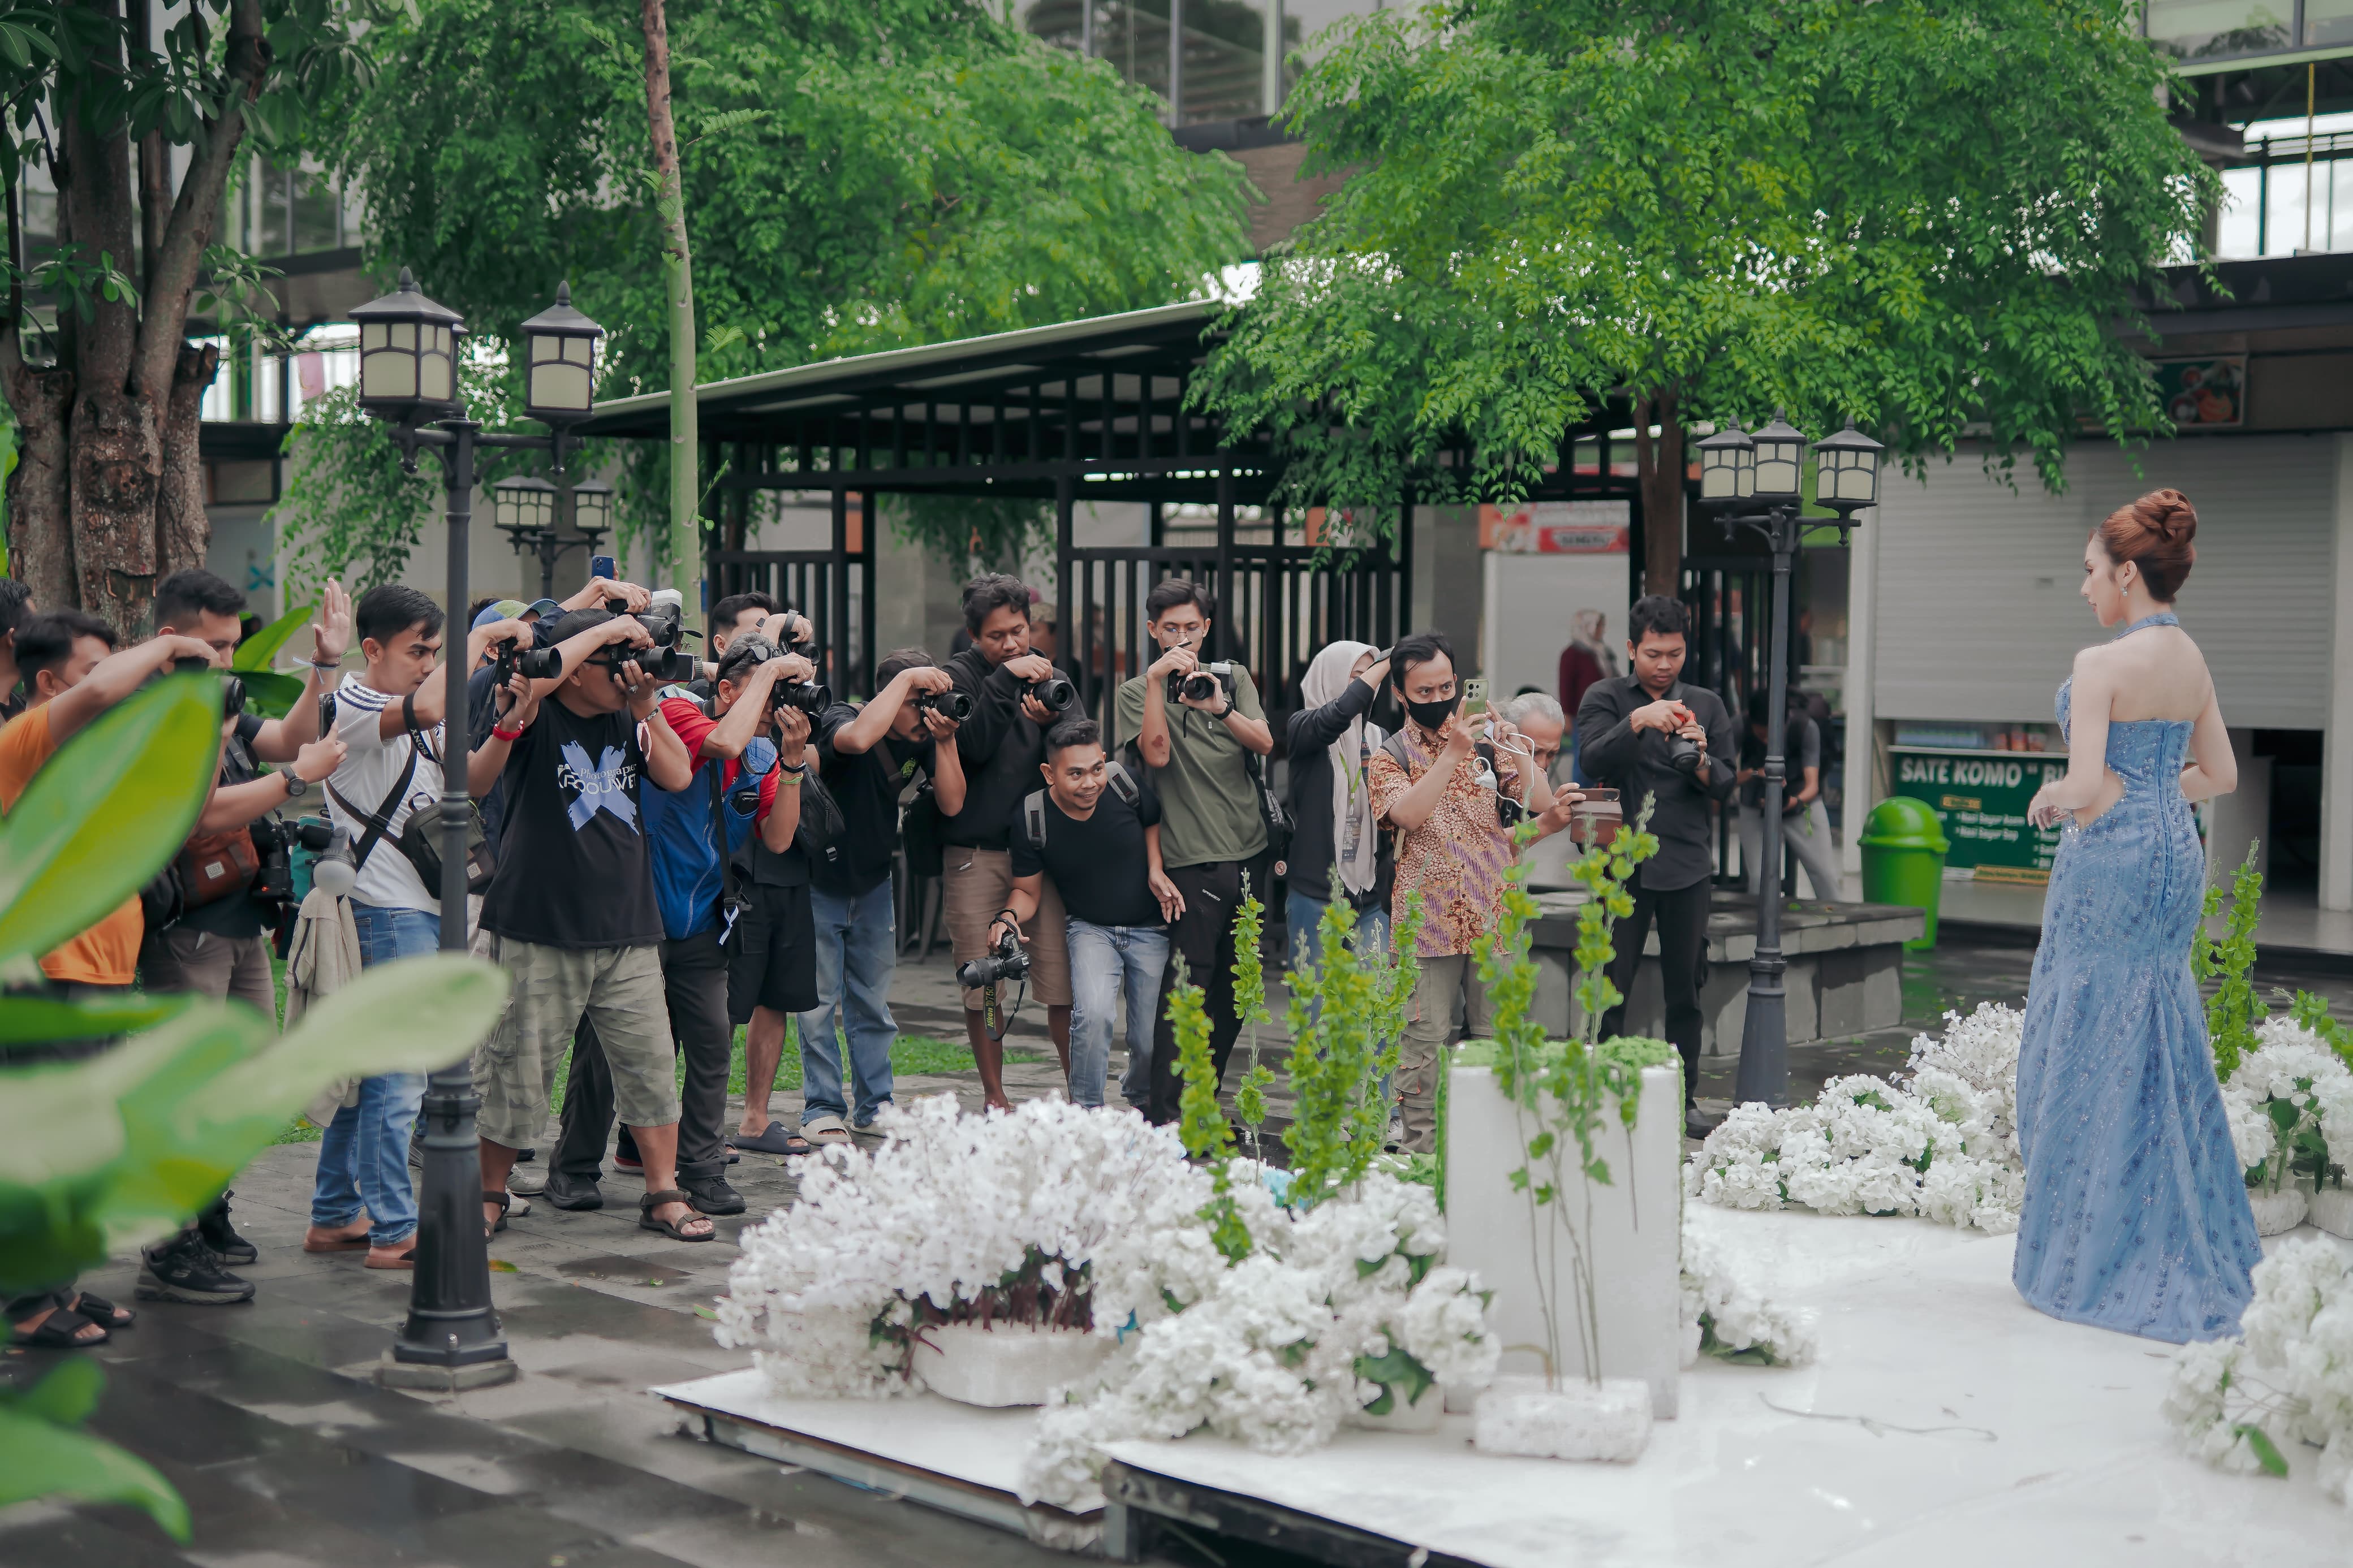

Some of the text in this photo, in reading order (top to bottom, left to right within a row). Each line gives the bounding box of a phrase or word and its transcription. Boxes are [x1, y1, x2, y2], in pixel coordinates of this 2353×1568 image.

[410, 728, 429, 755] SONY
[1901, 758, 1949, 784] SATE
[1954, 761, 2022, 788] KOMO
